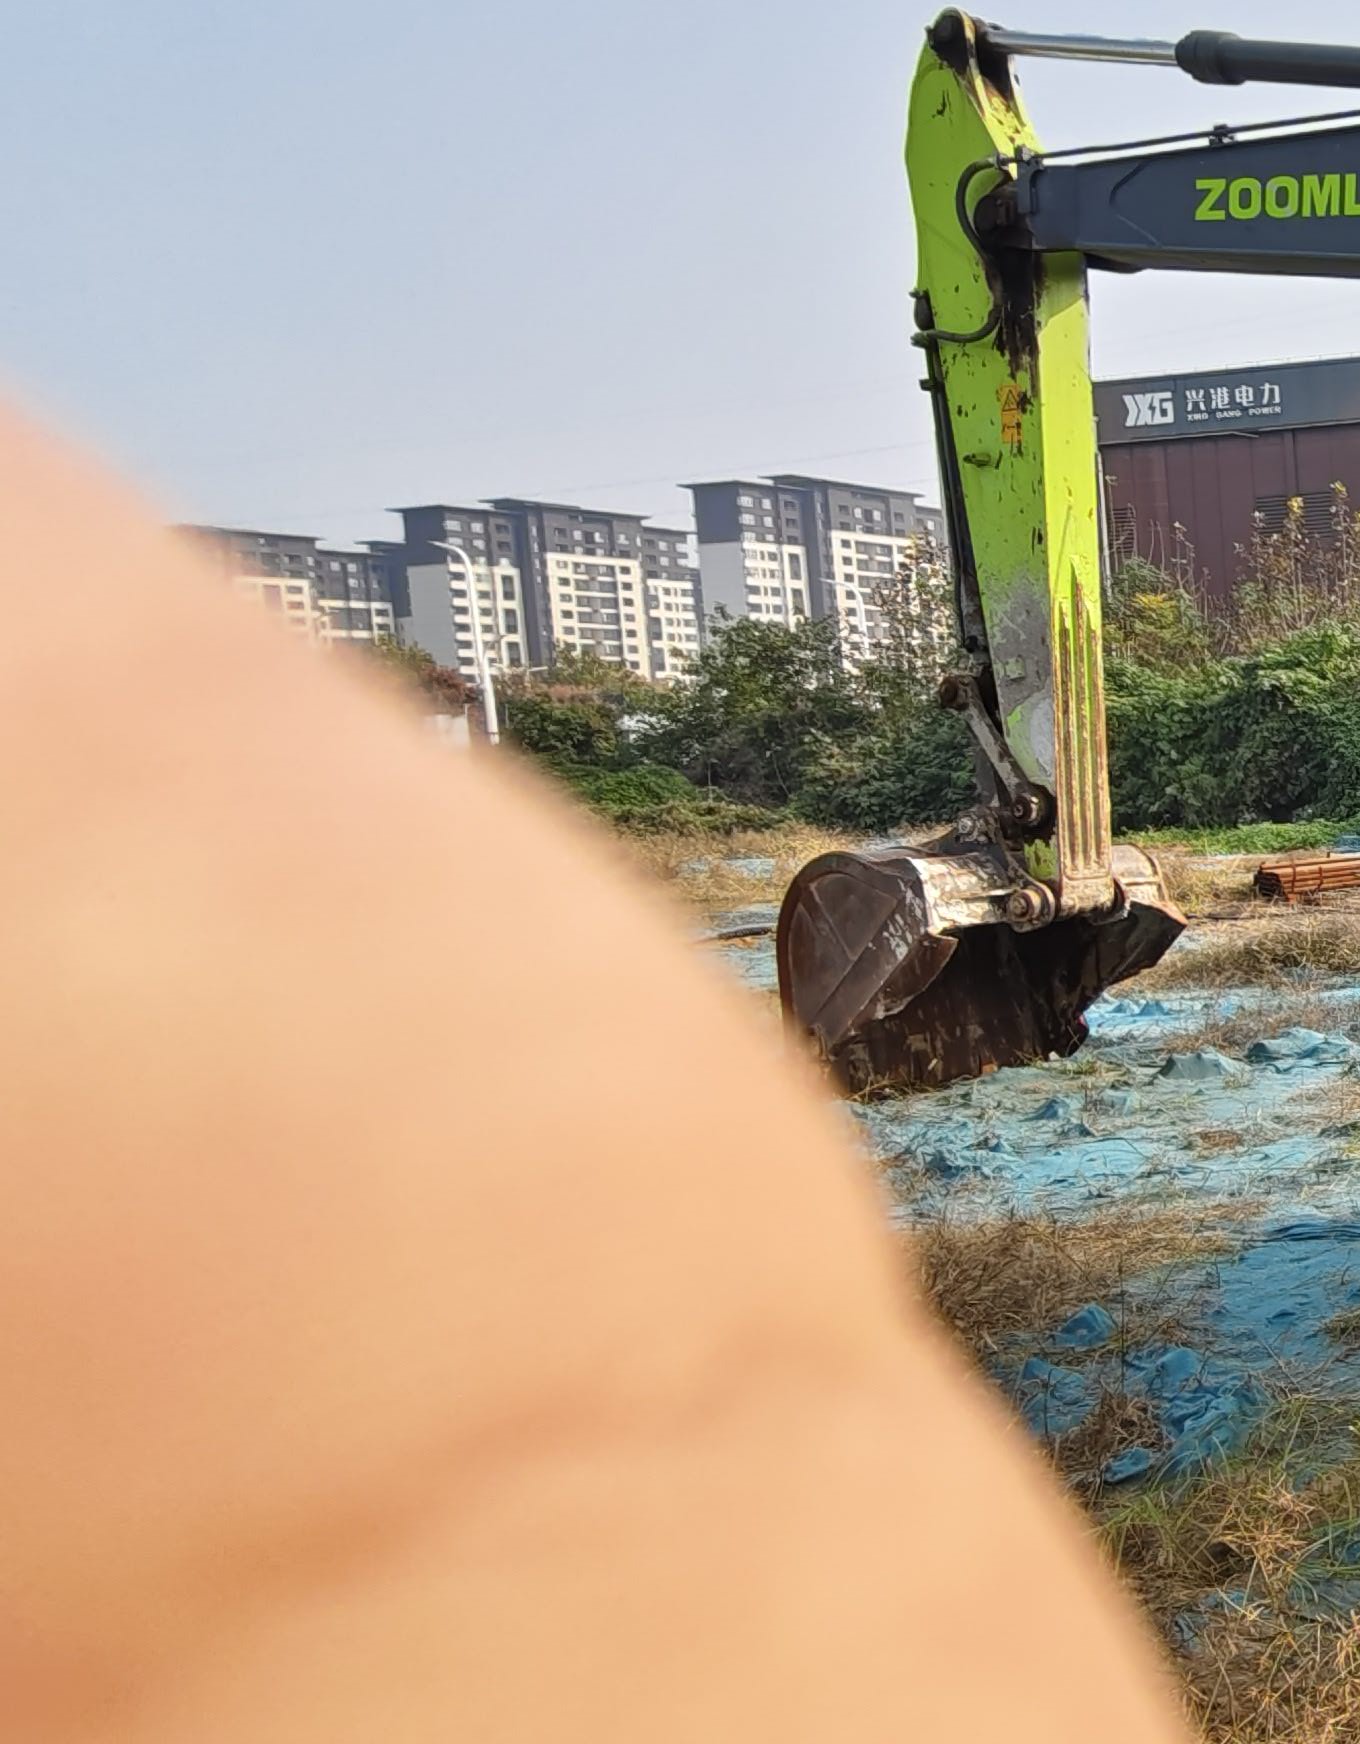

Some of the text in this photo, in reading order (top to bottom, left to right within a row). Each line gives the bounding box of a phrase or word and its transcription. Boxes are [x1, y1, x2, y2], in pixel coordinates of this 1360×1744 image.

[1185, 382, 1281, 412] 兴港电力
[1248, 406, 1281, 416] POWER
